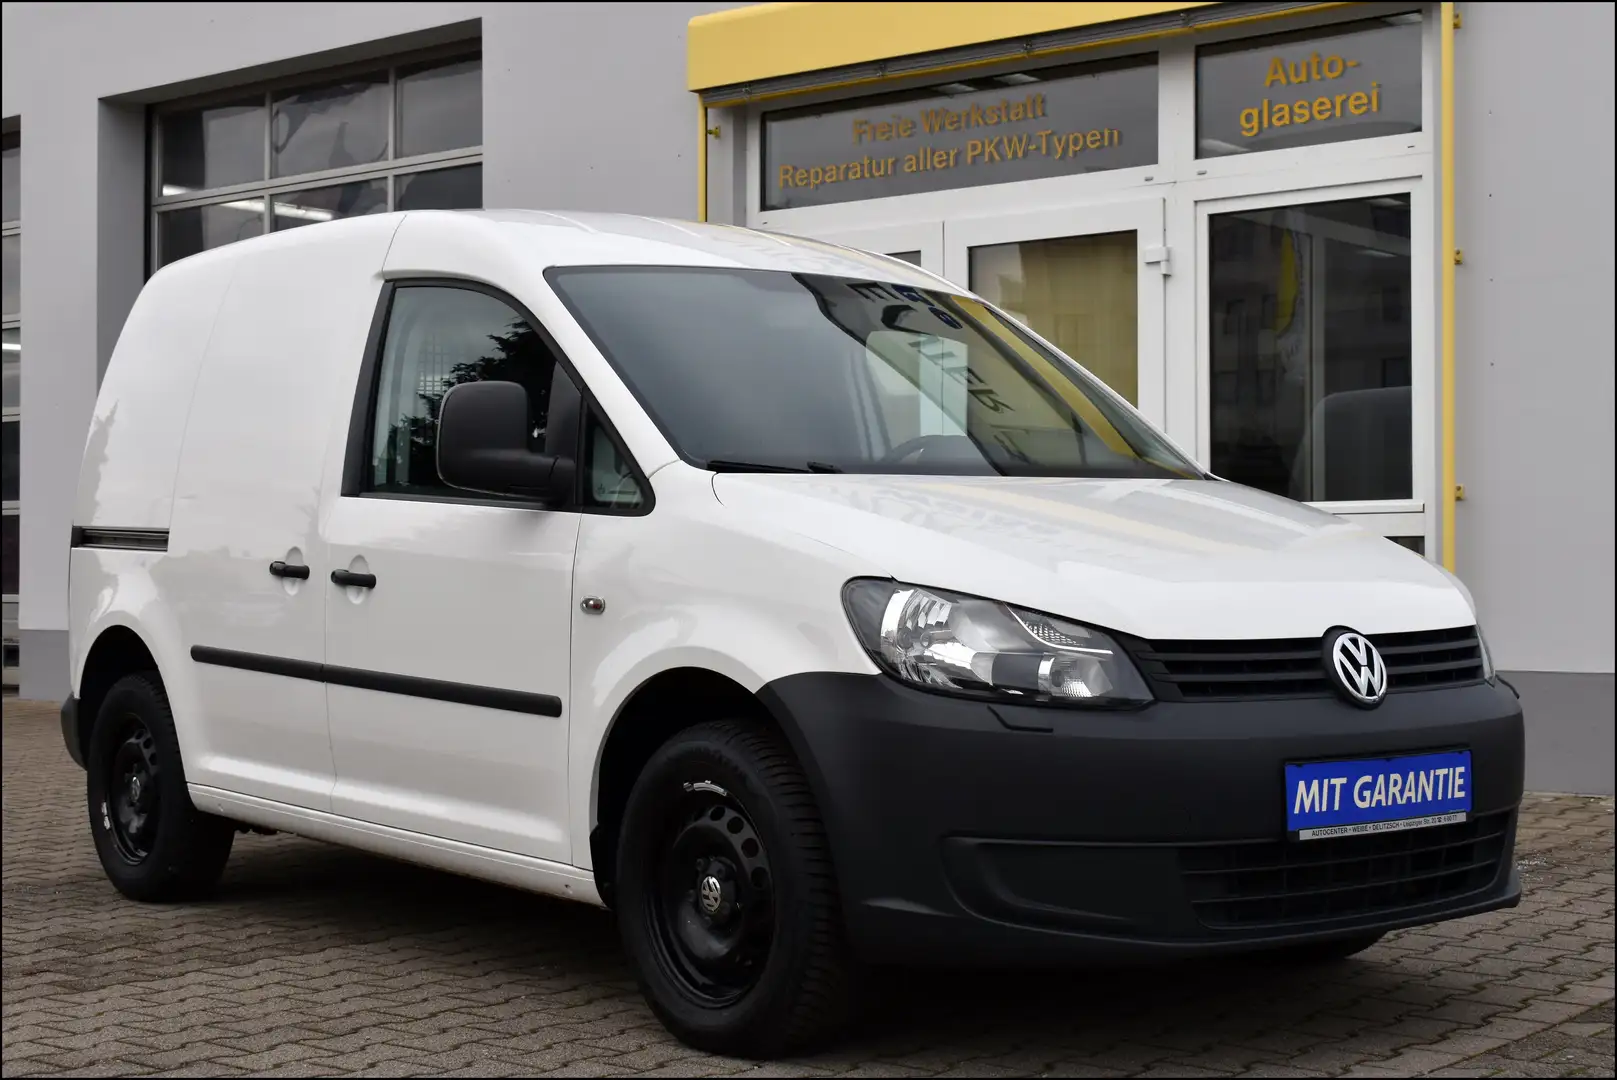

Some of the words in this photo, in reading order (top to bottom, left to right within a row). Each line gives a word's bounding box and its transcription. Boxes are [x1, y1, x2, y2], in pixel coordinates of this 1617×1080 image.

[1264, 50, 1360, 87] Auto-
[852, 113, 914, 144] Freie
[920, 93, 1045, 133] Werkstatt
[1239, 81, 1379, 137] glaserei
[778, 155, 896, 189] Reparatur
[903, 146, 959, 174] aller
[966, 128, 1120, 165] PKW-Typen
[1294, 777, 1347, 814] MIT
[1353, 766, 1466, 808] GARANTIE
[1311, 826, 1348, 837] AUTOCENTER
